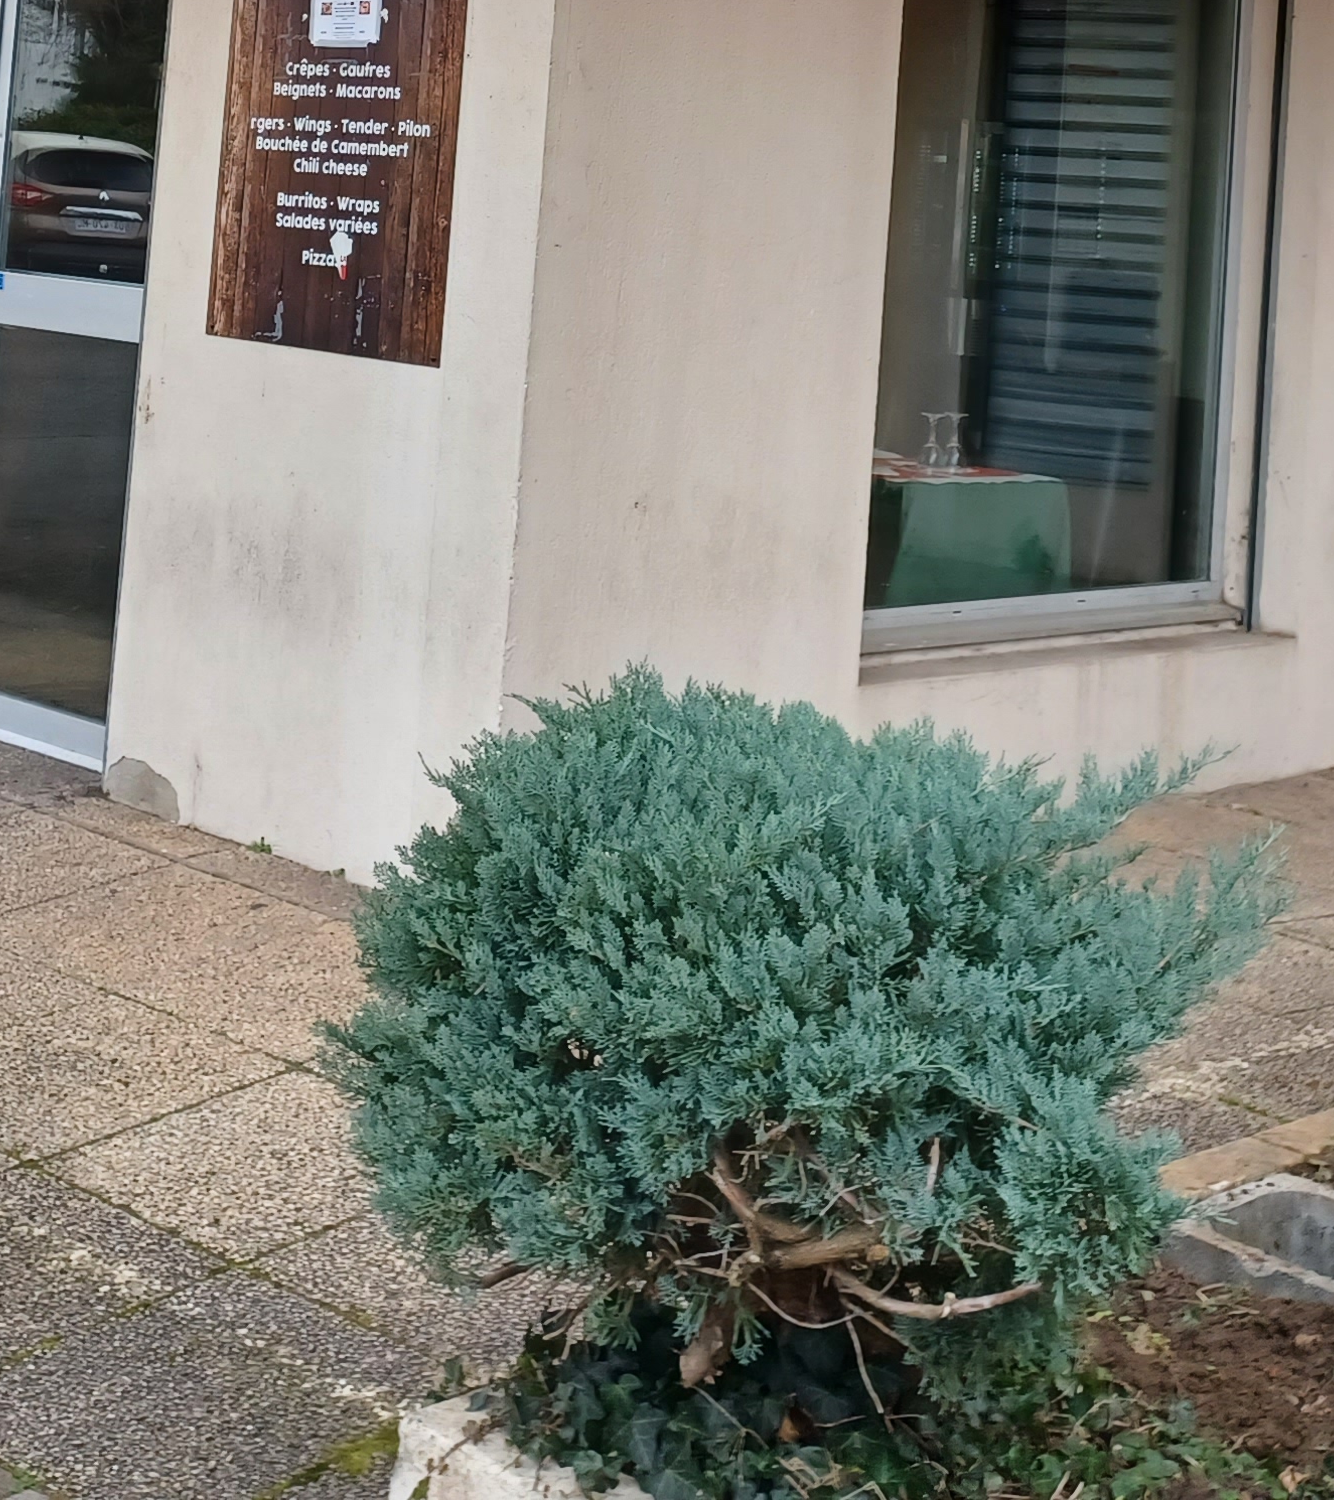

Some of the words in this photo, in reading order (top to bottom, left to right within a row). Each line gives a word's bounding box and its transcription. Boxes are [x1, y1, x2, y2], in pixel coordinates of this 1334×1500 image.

[286, 58, 329, 79] Crêpes
[339, 61, 391, 78] Gaufres
[273, 80, 326, 100] Beignets
[335, 83, 401, 99] Macarons
[294, 115, 331, 135] Wings
[341, 118, 388, 135] Tender
[398, 119, 431, 137] Pilon
[256, 136, 309, 153] Bouchée
[311, 138, 328, 153] de
[331, 140, 409, 158] Camembert
[293, 157, 319, 174] Chili
[322, 160, 367, 177] cheese
[277, 191, 327, 209] Burritos
[337, 196, 379, 216] Wraps
[276, 212, 326, 231] Salades
[329, 216, 378, 235] variées
